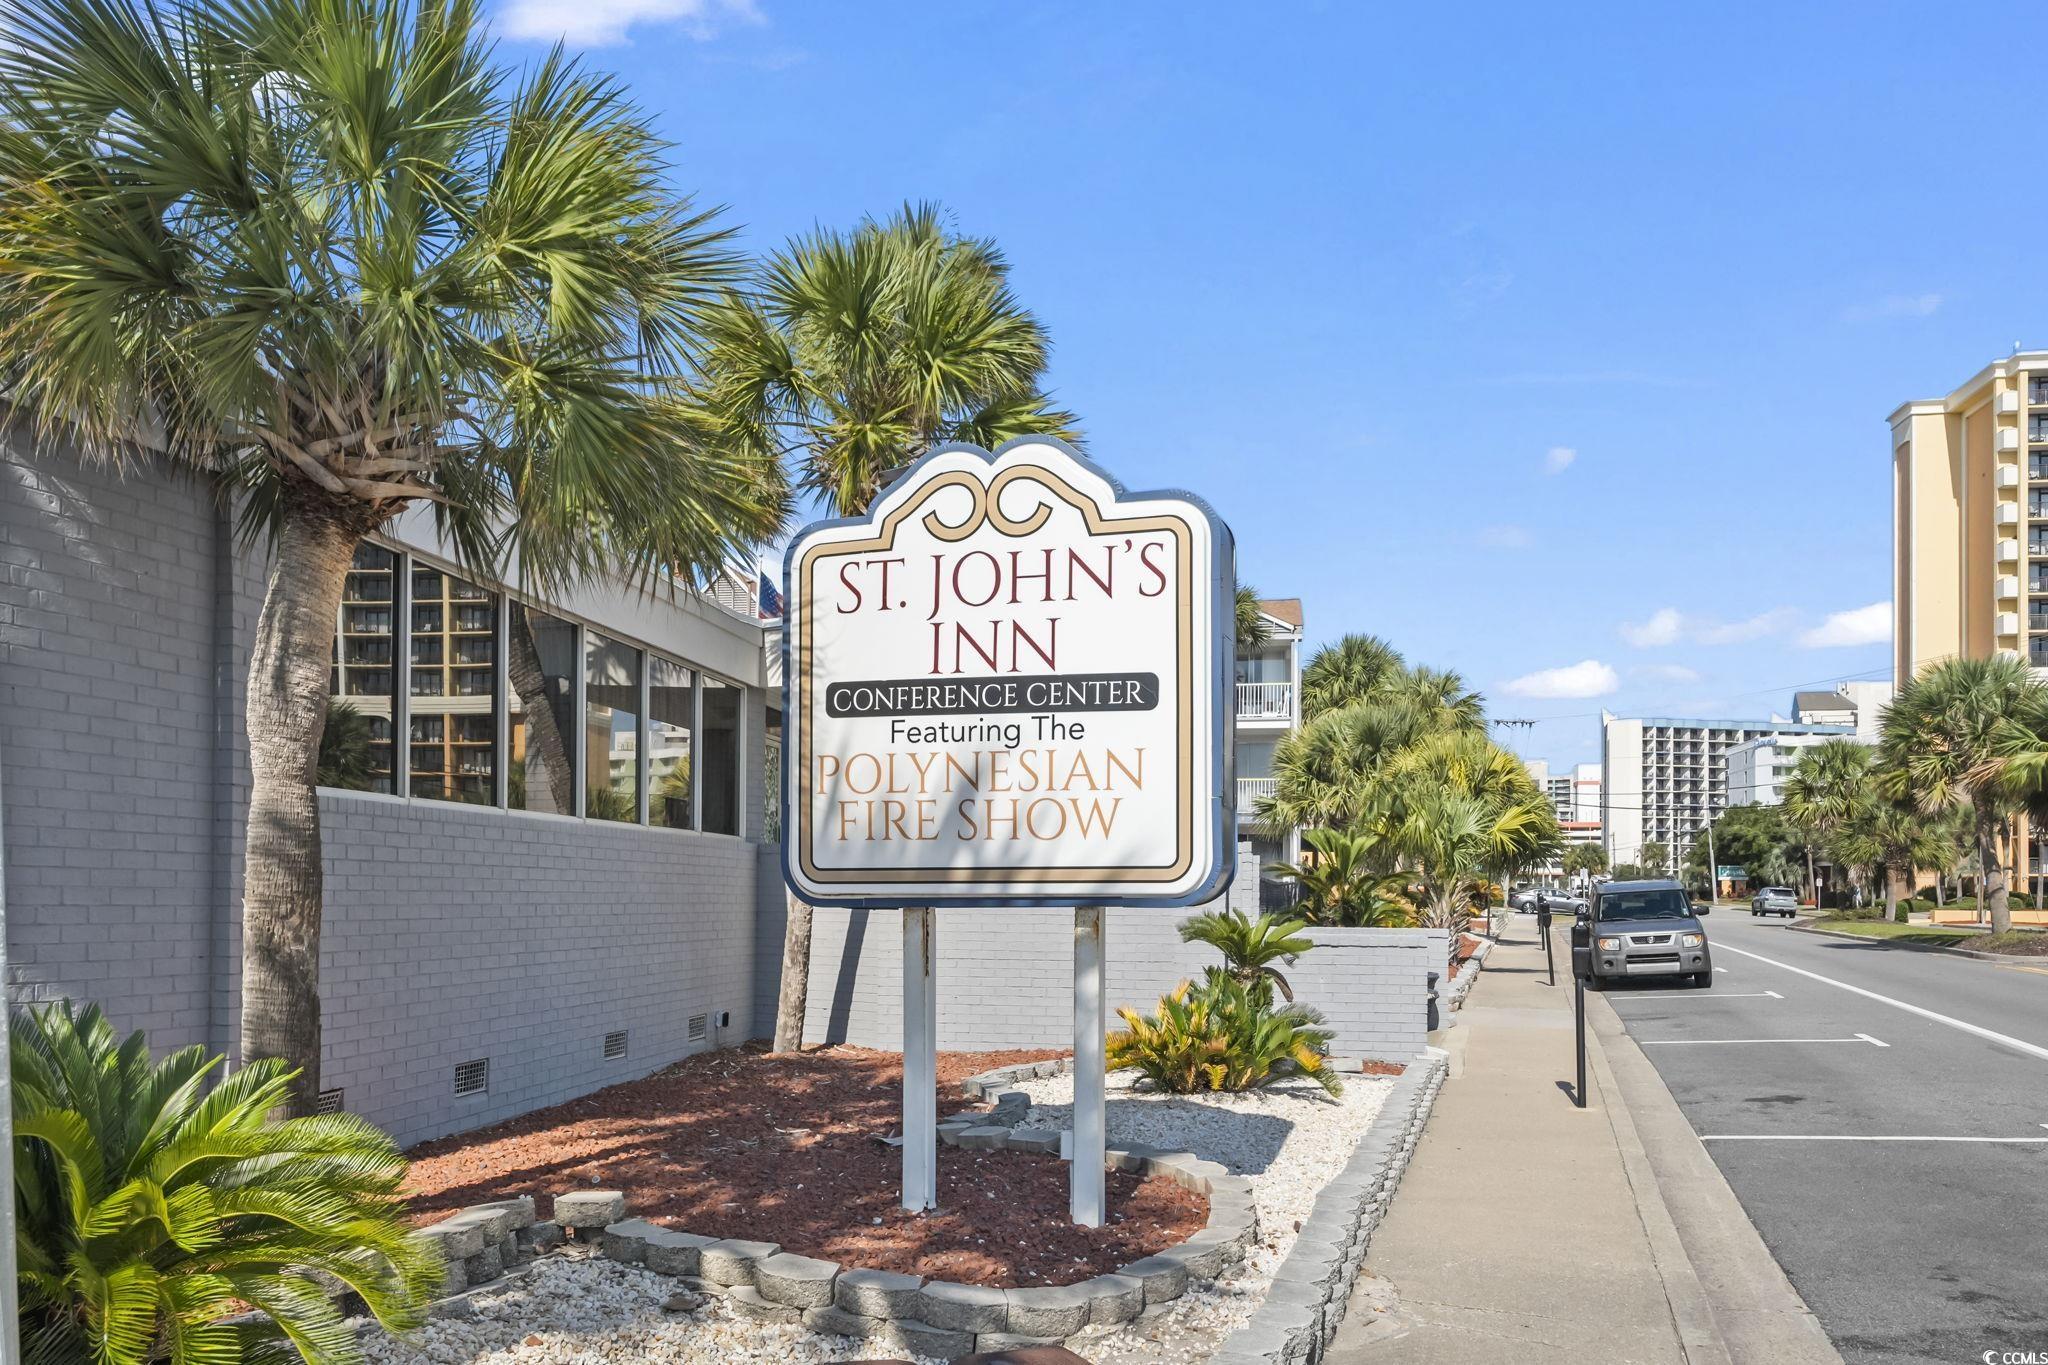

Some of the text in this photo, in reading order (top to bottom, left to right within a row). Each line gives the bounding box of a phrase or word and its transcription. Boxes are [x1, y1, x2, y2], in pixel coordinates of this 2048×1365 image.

[836, 539, 1168, 621] ST. JOHN'S
[928, 617, 1062, 675] INN
[833, 680, 1145, 712] CONFERENCE CENTER
[890, 714, 1085, 748] Featuring The
[816, 747, 1147, 795] POLYNESIAN
[837, 797, 1123, 842] FIRE SHOW
